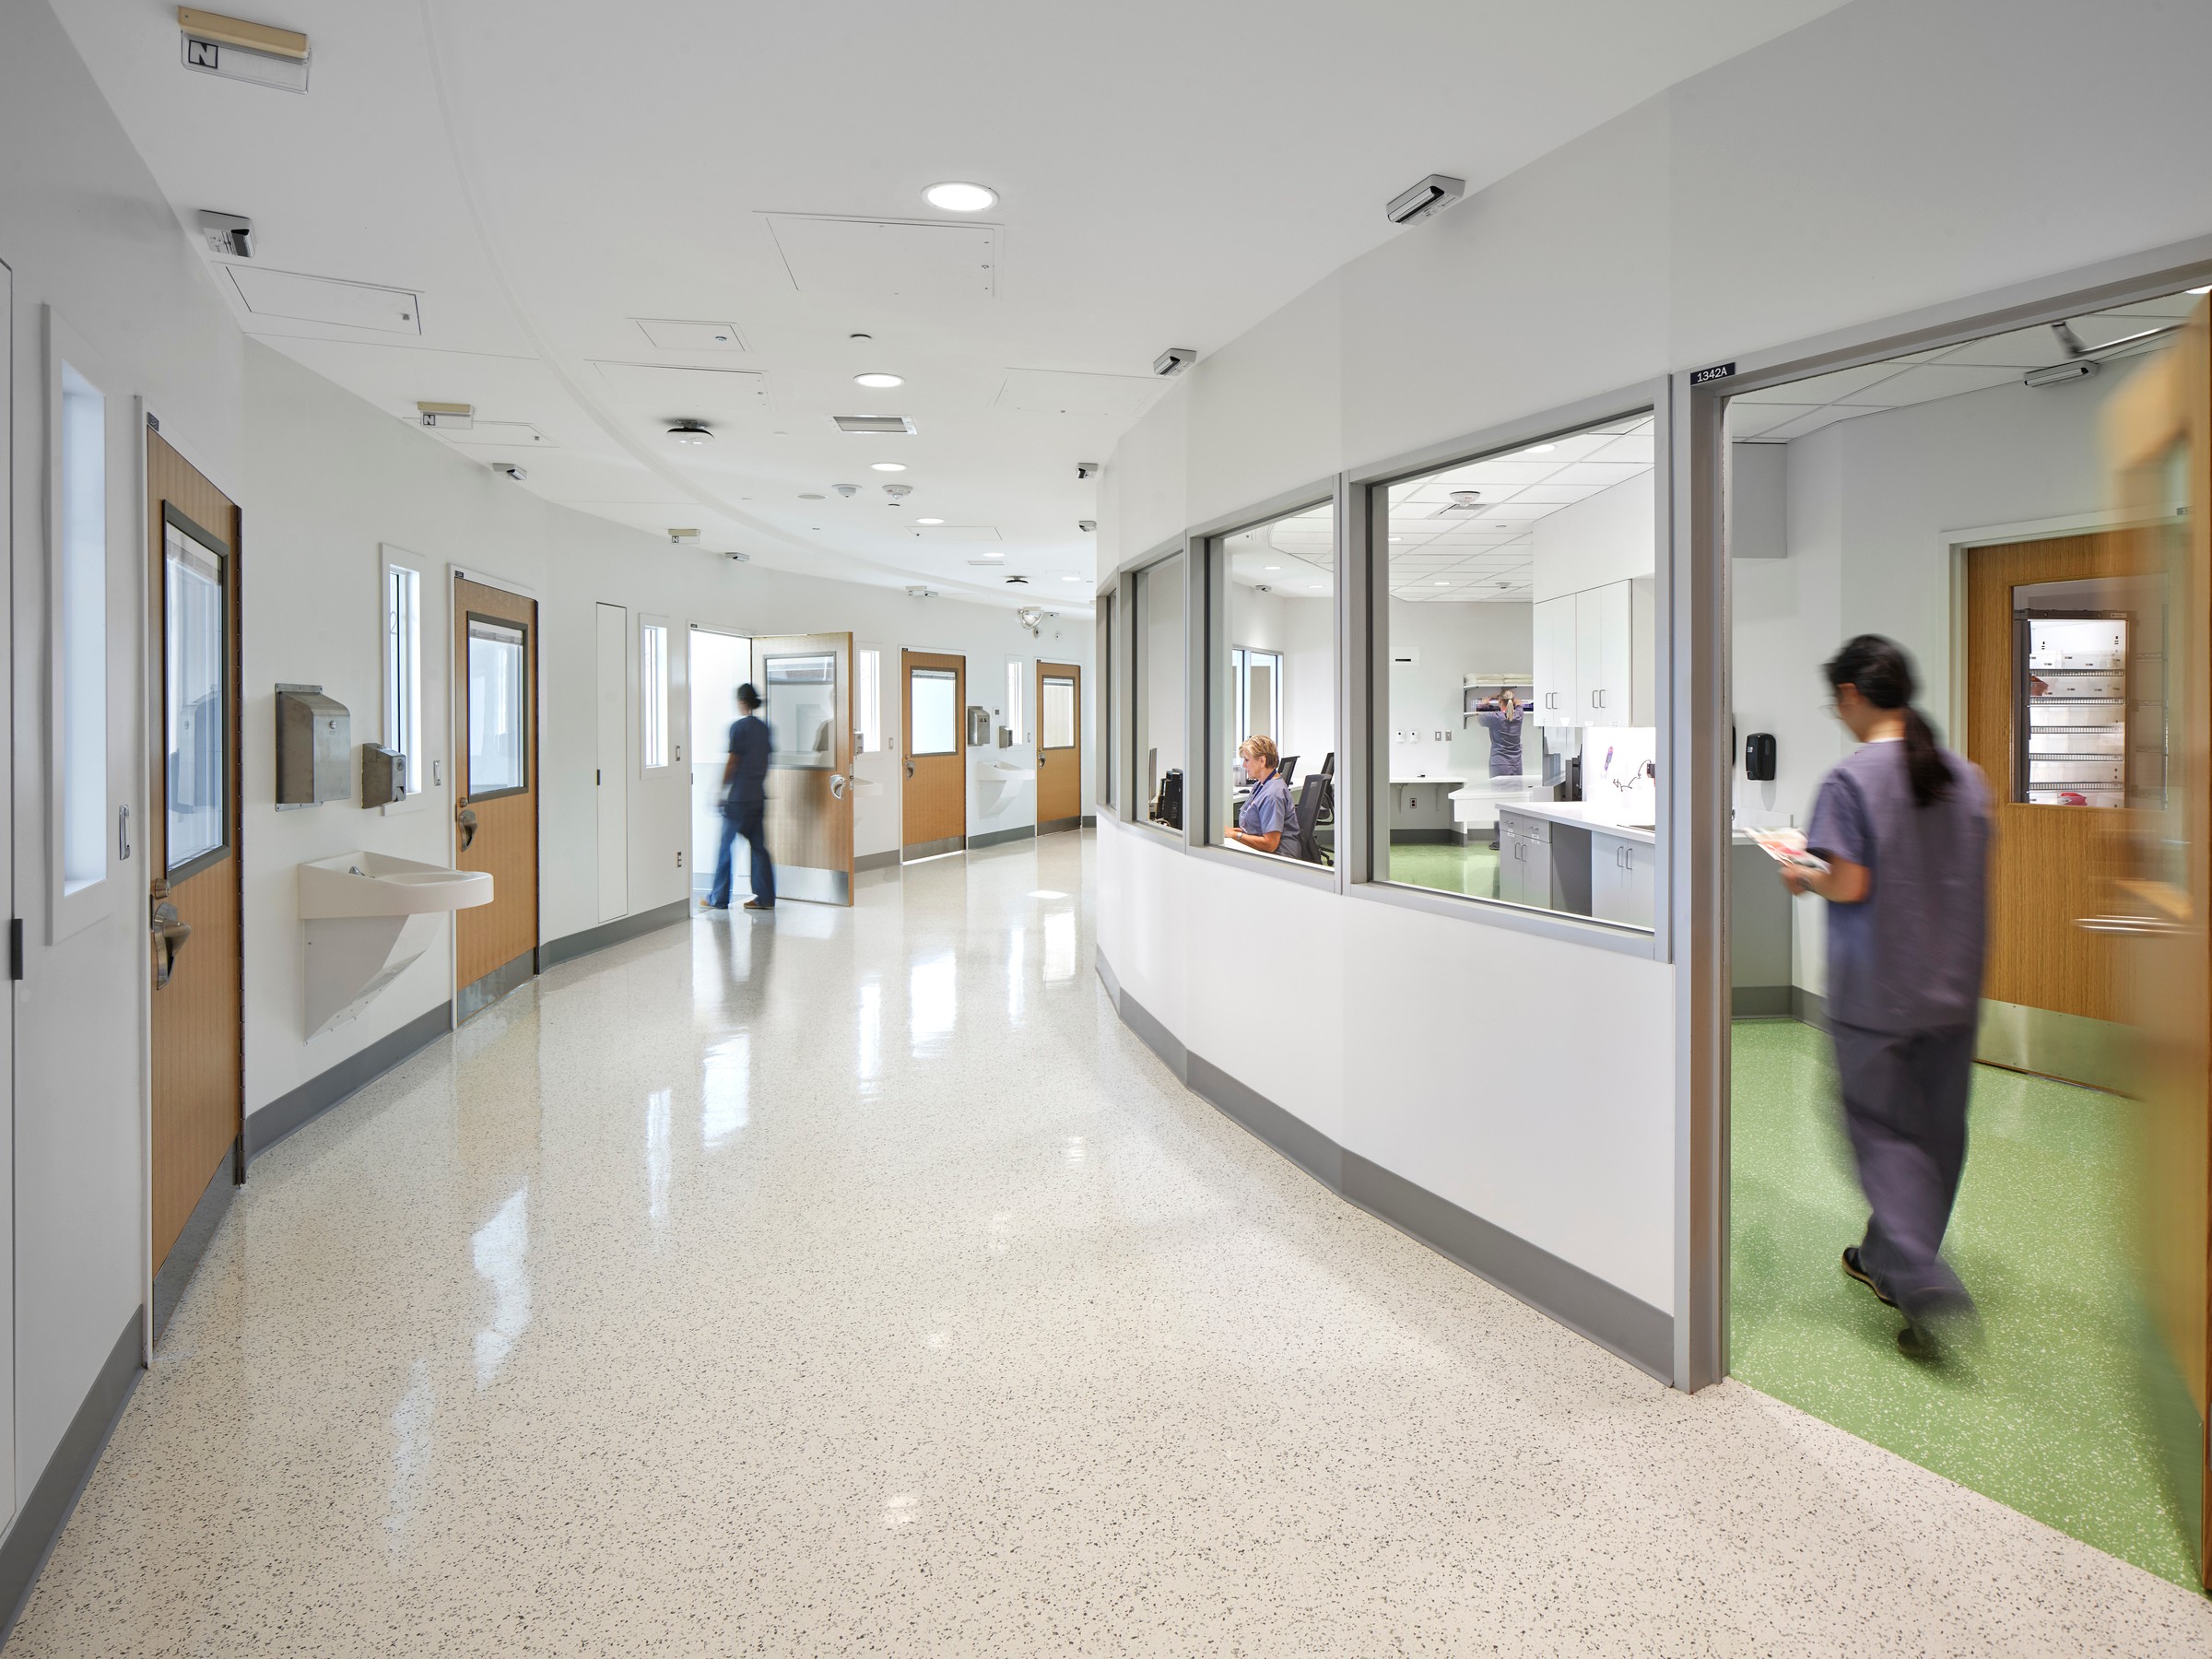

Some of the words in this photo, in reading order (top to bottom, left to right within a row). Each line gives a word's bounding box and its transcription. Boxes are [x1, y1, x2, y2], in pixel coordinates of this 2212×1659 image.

[189, 40, 218, 69] N
[1697, 367, 1727, 382] 1342A
[423, 414, 436, 426] N
